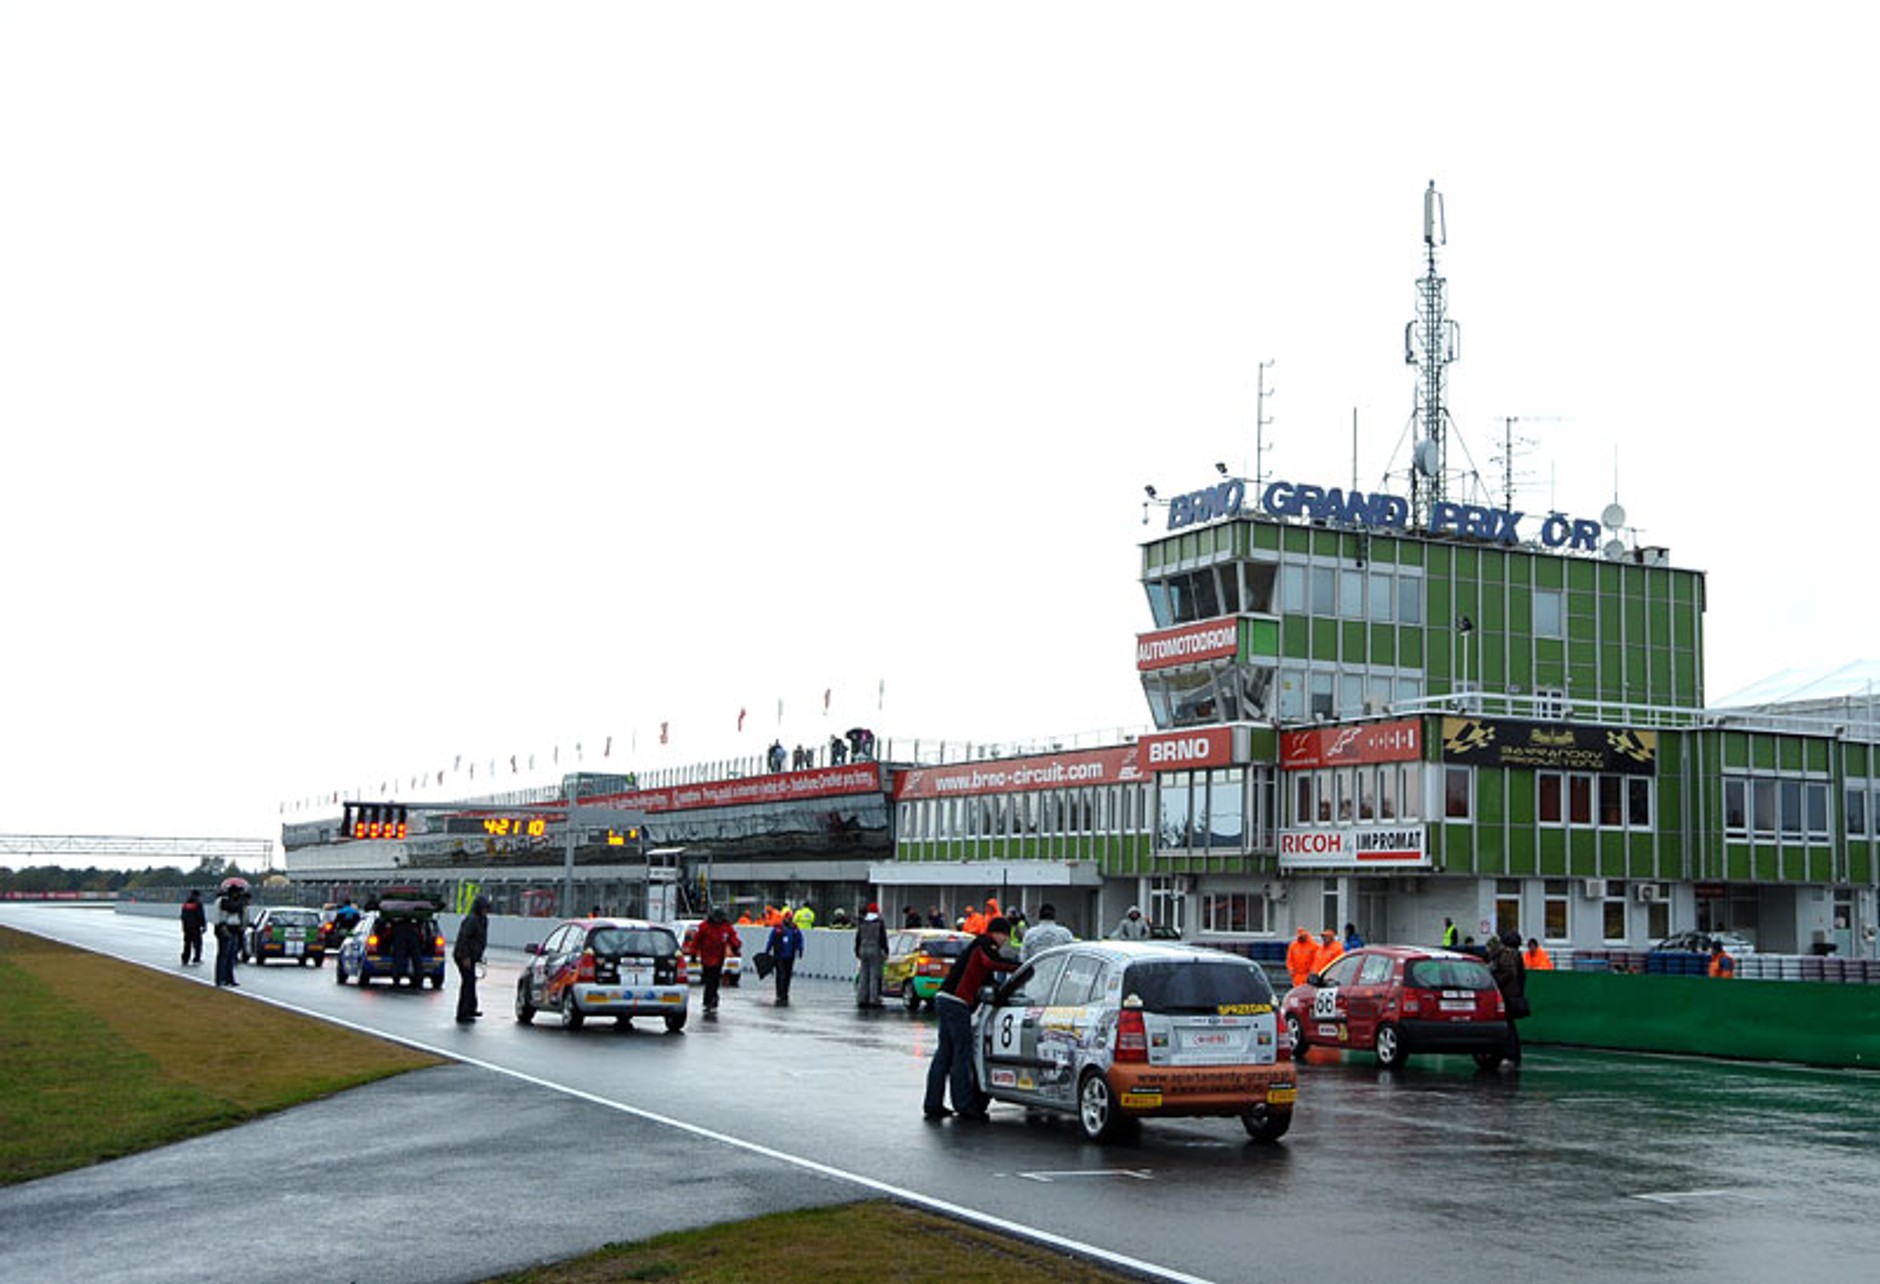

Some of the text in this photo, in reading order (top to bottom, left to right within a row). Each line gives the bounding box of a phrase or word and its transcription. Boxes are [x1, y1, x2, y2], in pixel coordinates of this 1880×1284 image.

[1168, 478, 1244, 529] BRNO
[1264, 481, 1408, 528] GRAND
[1429, 501, 1524, 545] PRIX
[1138, 626, 1236, 661] AUTOMOTODROM
[1149, 738, 1209, 763] BRNO
[1282, 833, 1341, 853] RICOH
[1356, 831, 1421, 850] IMPROMAT
[1002, 1014, 1014, 1049] 8
